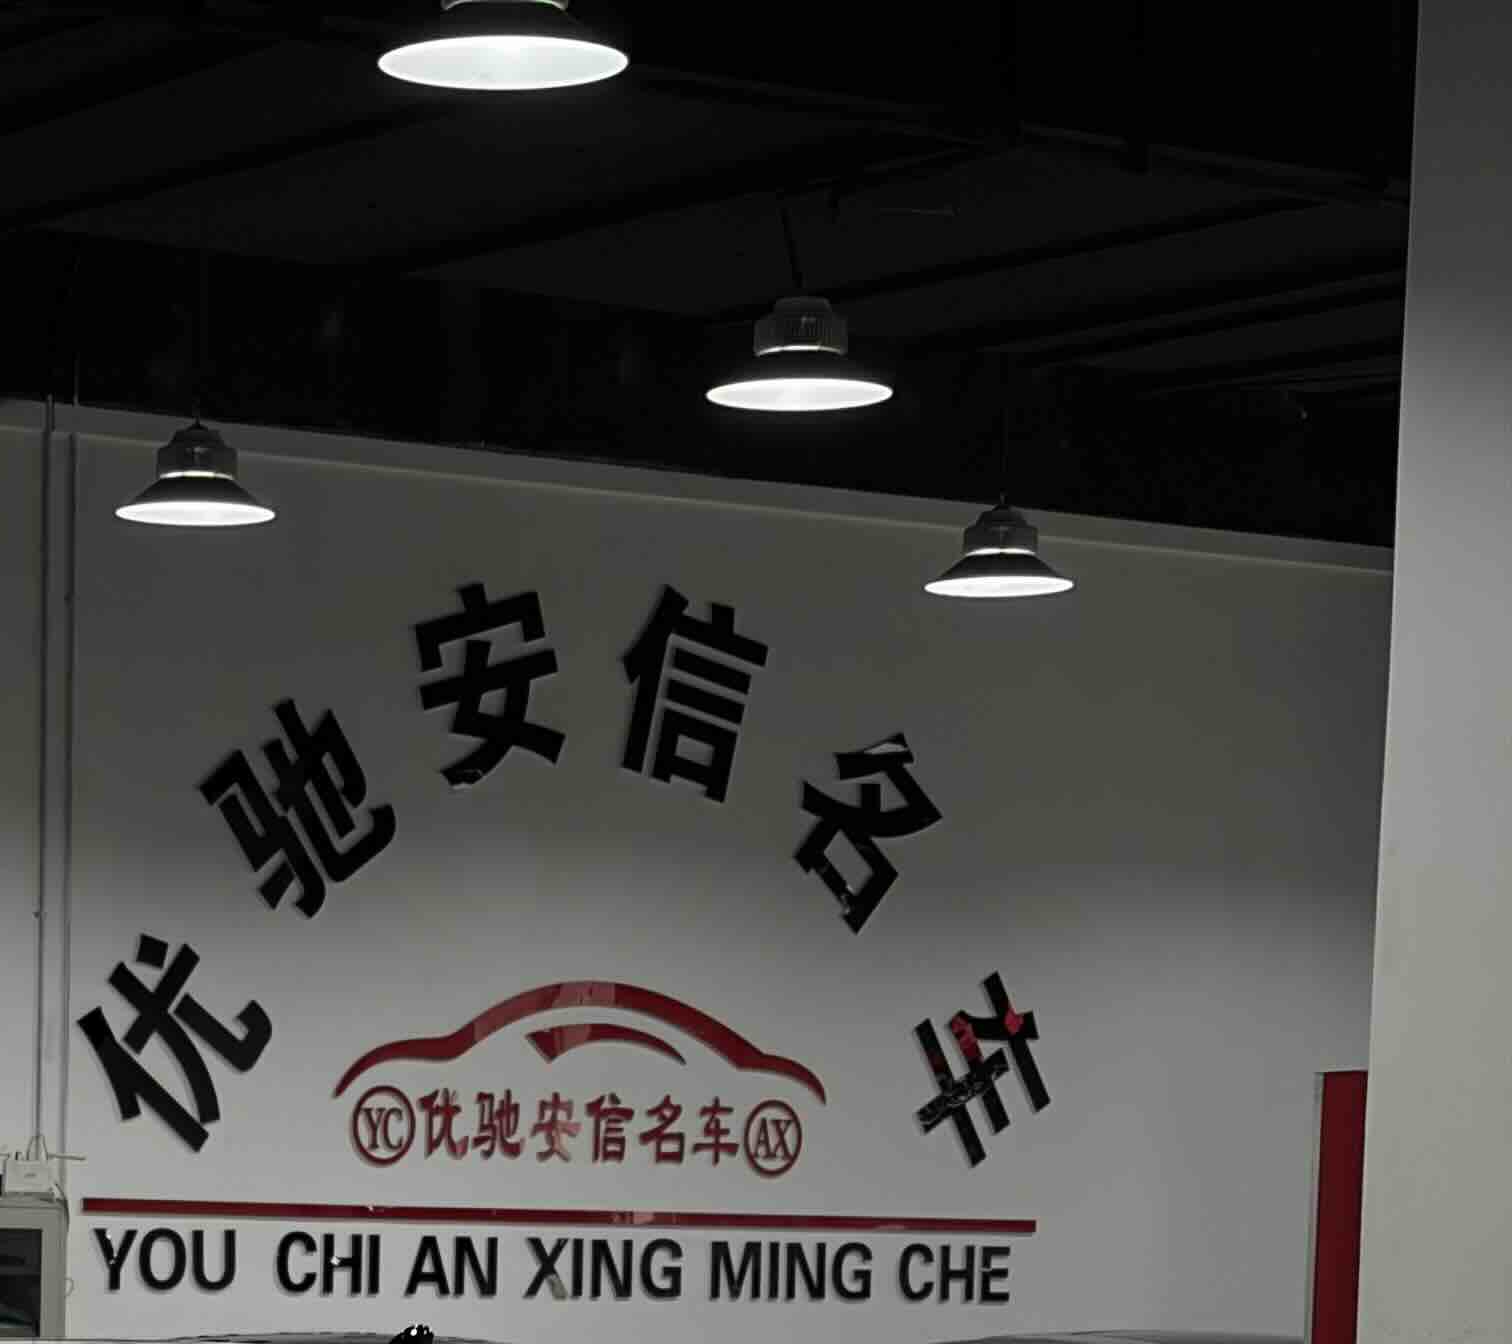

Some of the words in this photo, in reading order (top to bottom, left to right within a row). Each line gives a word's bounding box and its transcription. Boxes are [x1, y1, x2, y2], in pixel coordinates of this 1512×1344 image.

[418, 1088, 739, 1166] 优驰安信名车
[94, 1227, 237, 1292] YOU
[276, 1231, 381, 1295] CHI
[405, 1235, 498, 1297] AN
[524, 1237, 684, 1299] XING
[710, 1240, 874, 1302] MING
[898, 1243, 1011, 1303] CHE
